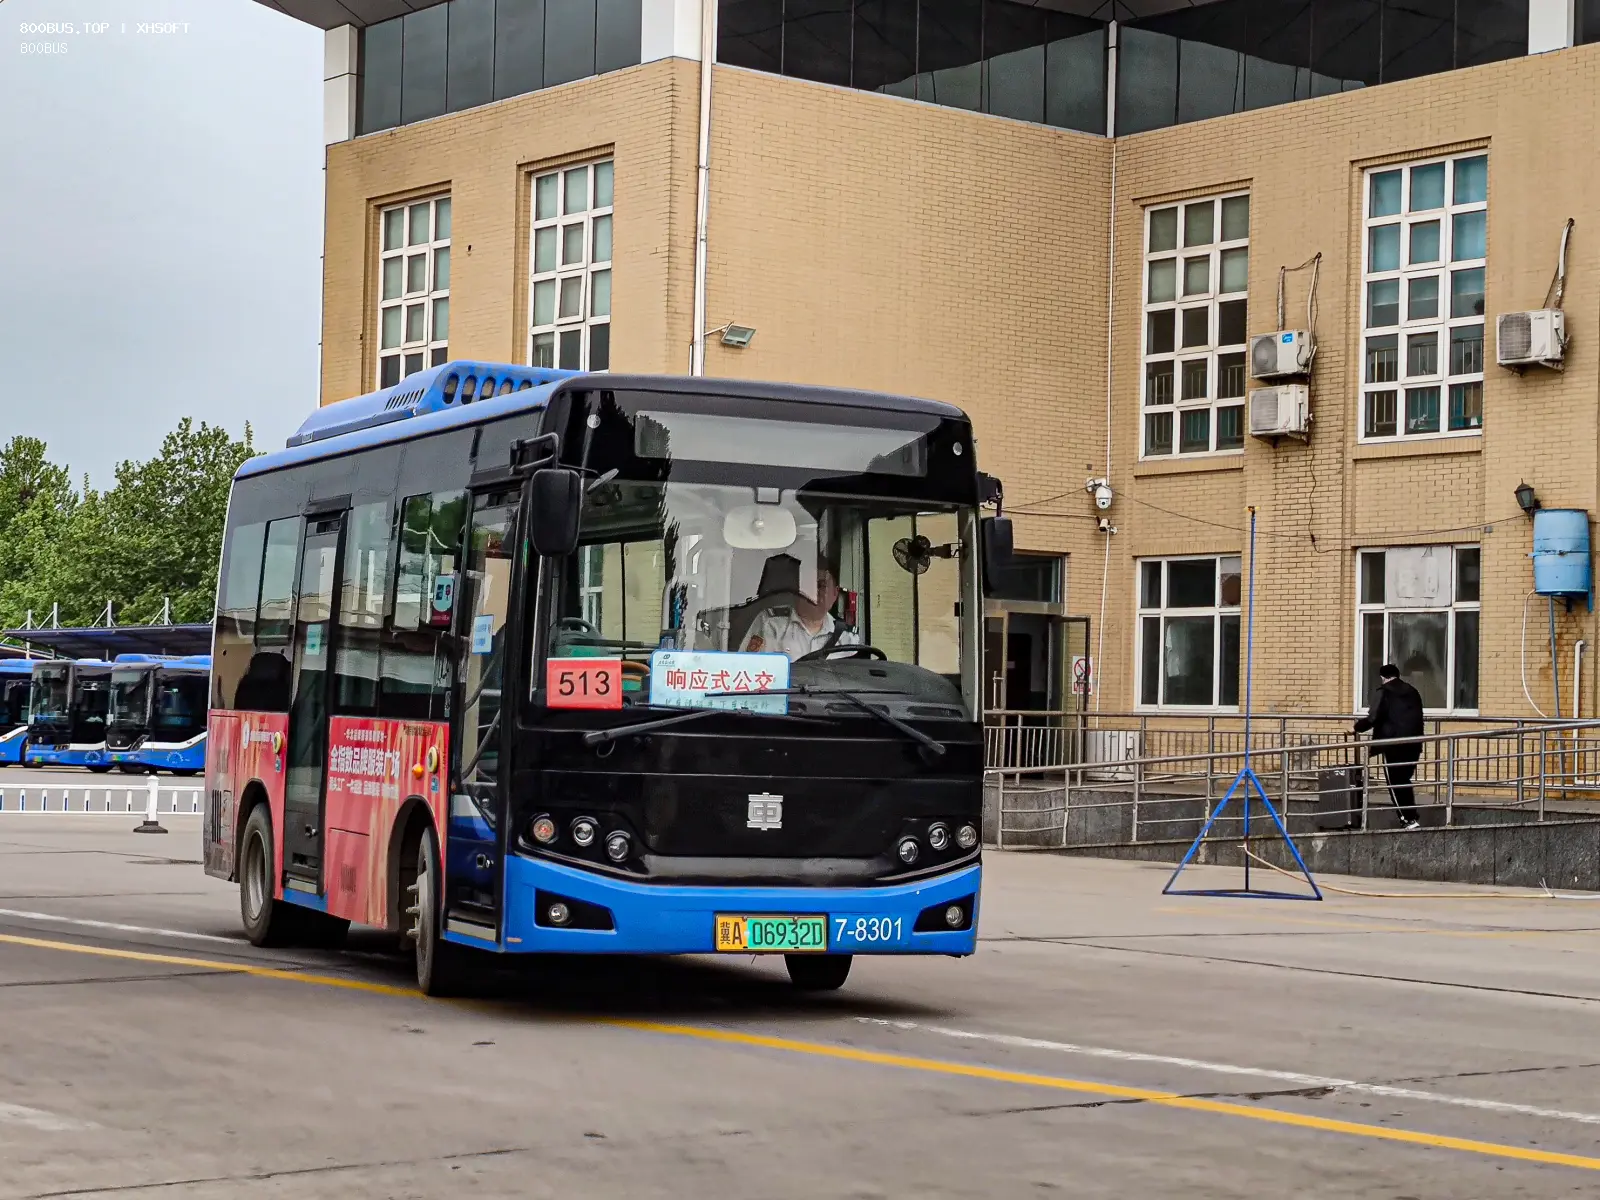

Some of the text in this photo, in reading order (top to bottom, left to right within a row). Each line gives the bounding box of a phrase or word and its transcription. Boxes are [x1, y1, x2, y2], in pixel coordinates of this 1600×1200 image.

[558, 670, 610, 696] 513
[666, 668, 774, 692] 响应式公交
[835, 916, 903, 943] 7-8301
